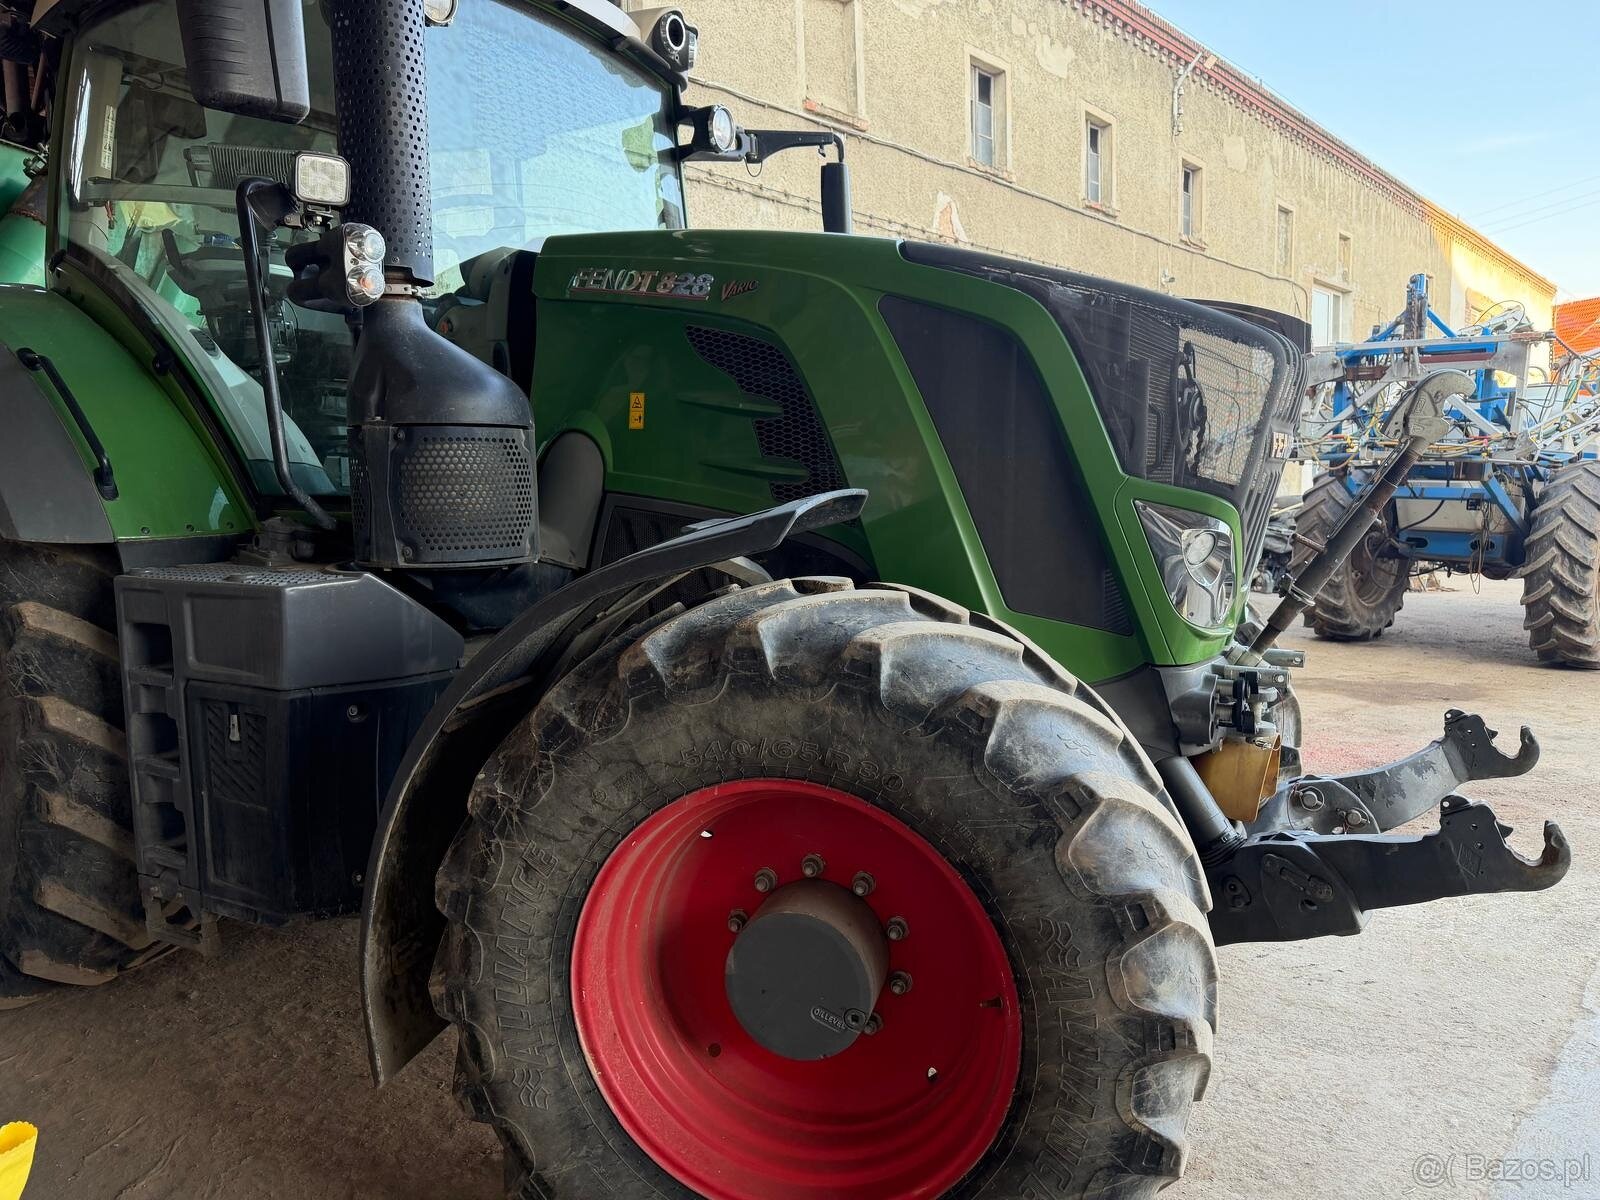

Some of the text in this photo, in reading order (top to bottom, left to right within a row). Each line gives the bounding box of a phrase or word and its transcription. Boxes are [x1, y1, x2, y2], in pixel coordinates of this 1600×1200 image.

[571, 267, 660, 293] FENDT
[656, 272, 715, 296] 828
[495, 839, 560, 1065] ALLIANCE
